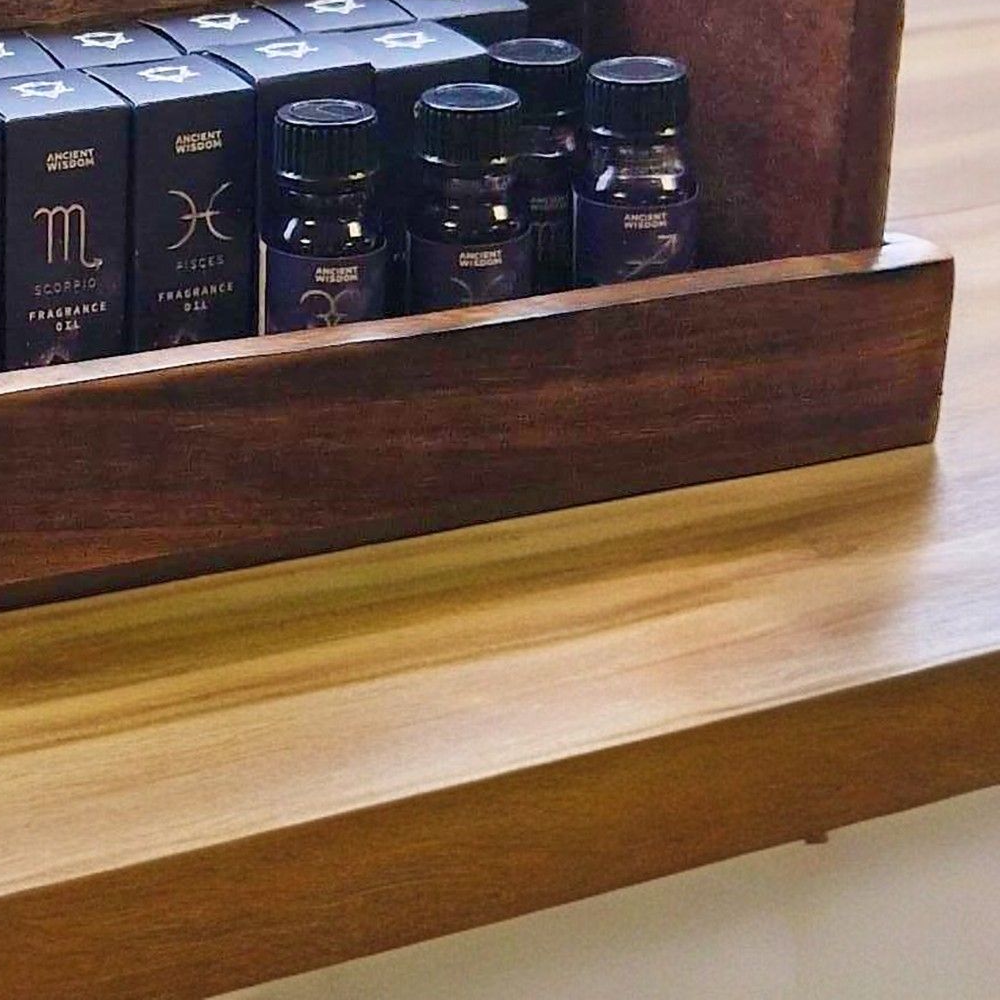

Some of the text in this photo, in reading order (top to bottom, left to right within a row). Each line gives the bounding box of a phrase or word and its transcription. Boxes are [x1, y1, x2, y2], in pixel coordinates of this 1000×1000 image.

[175, 130, 223, 146] ANCIENT
[175, 139, 223, 155] WISDOM
[46, 148, 95, 164] ANCIENT
[47, 158, 95, 173] WISDOM
[33, 278, 97, 297] SCORPIO
[158, 282, 234, 302] FRAGRANCE
[28, 301, 108, 322] FRAGRANCE
[184, 299, 209, 312] OIL
[55, 320, 82, 332] OIL
